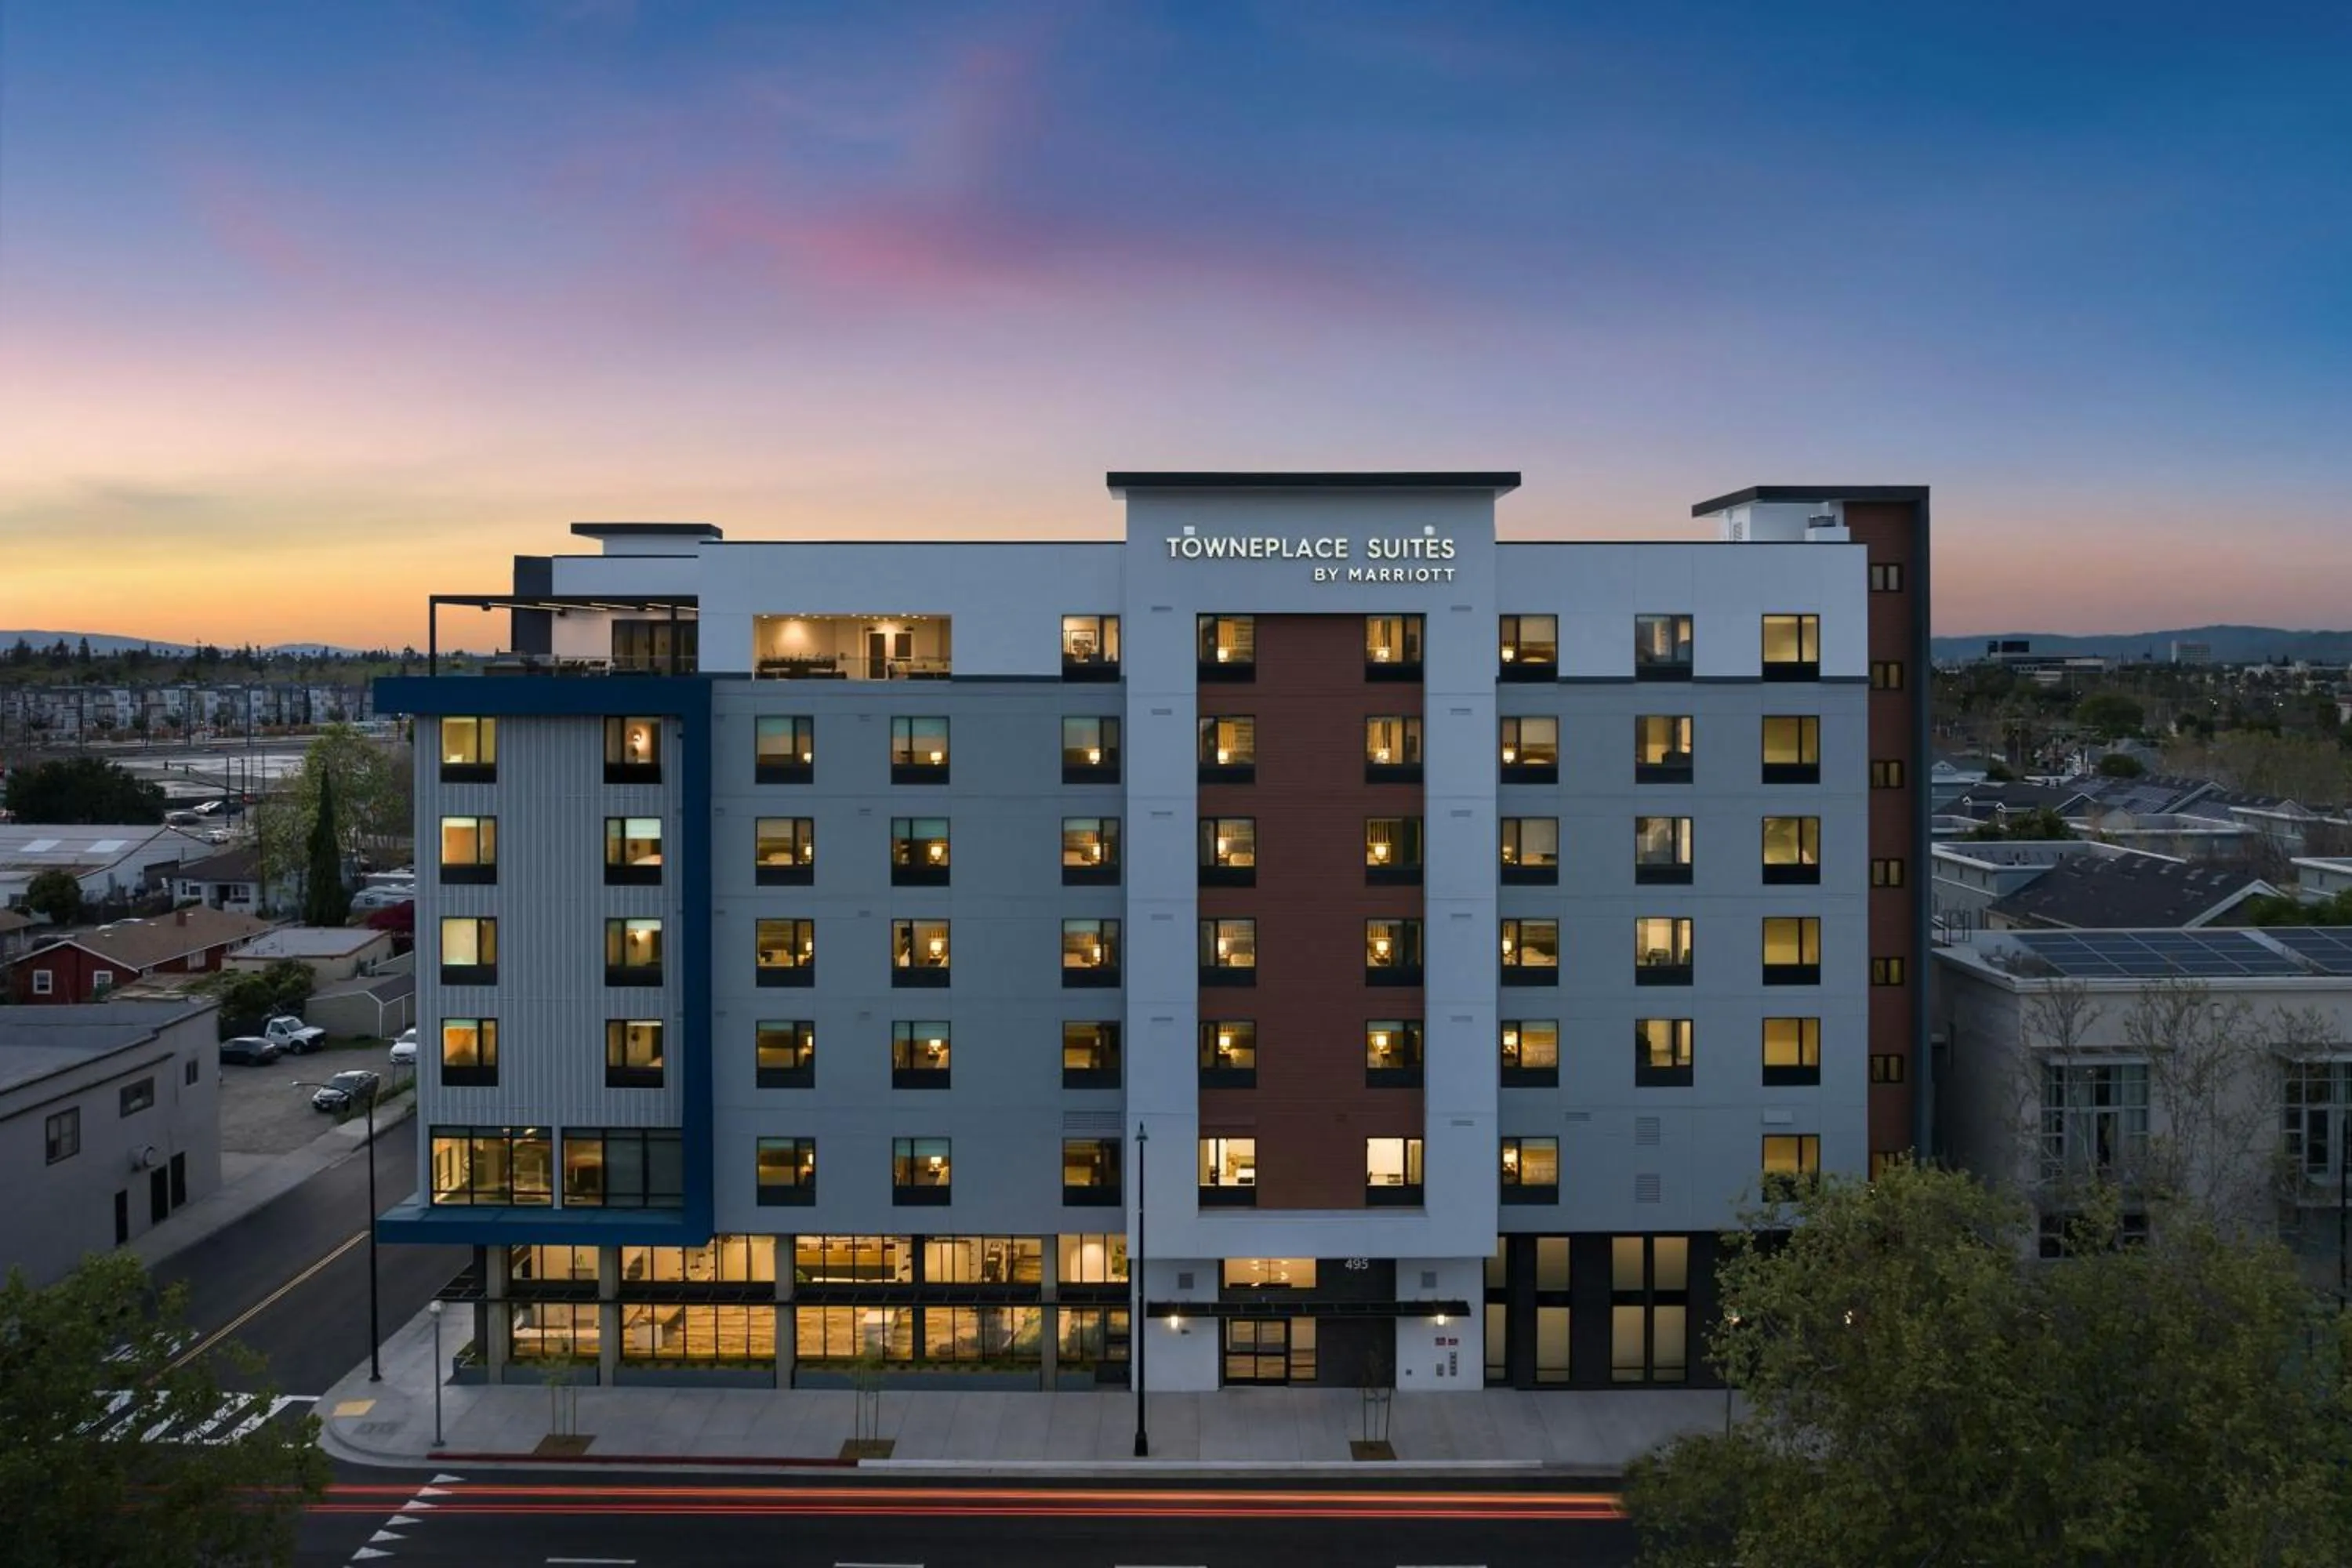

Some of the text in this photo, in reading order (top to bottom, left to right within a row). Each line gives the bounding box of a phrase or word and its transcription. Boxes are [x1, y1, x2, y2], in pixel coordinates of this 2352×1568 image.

[1166, 537, 1456, 559] TOWNEPLACE SUITES
[1314, 568, 1456, 582] BY MARRIOTT
[1345, 1258, 1368, 1270] 495
